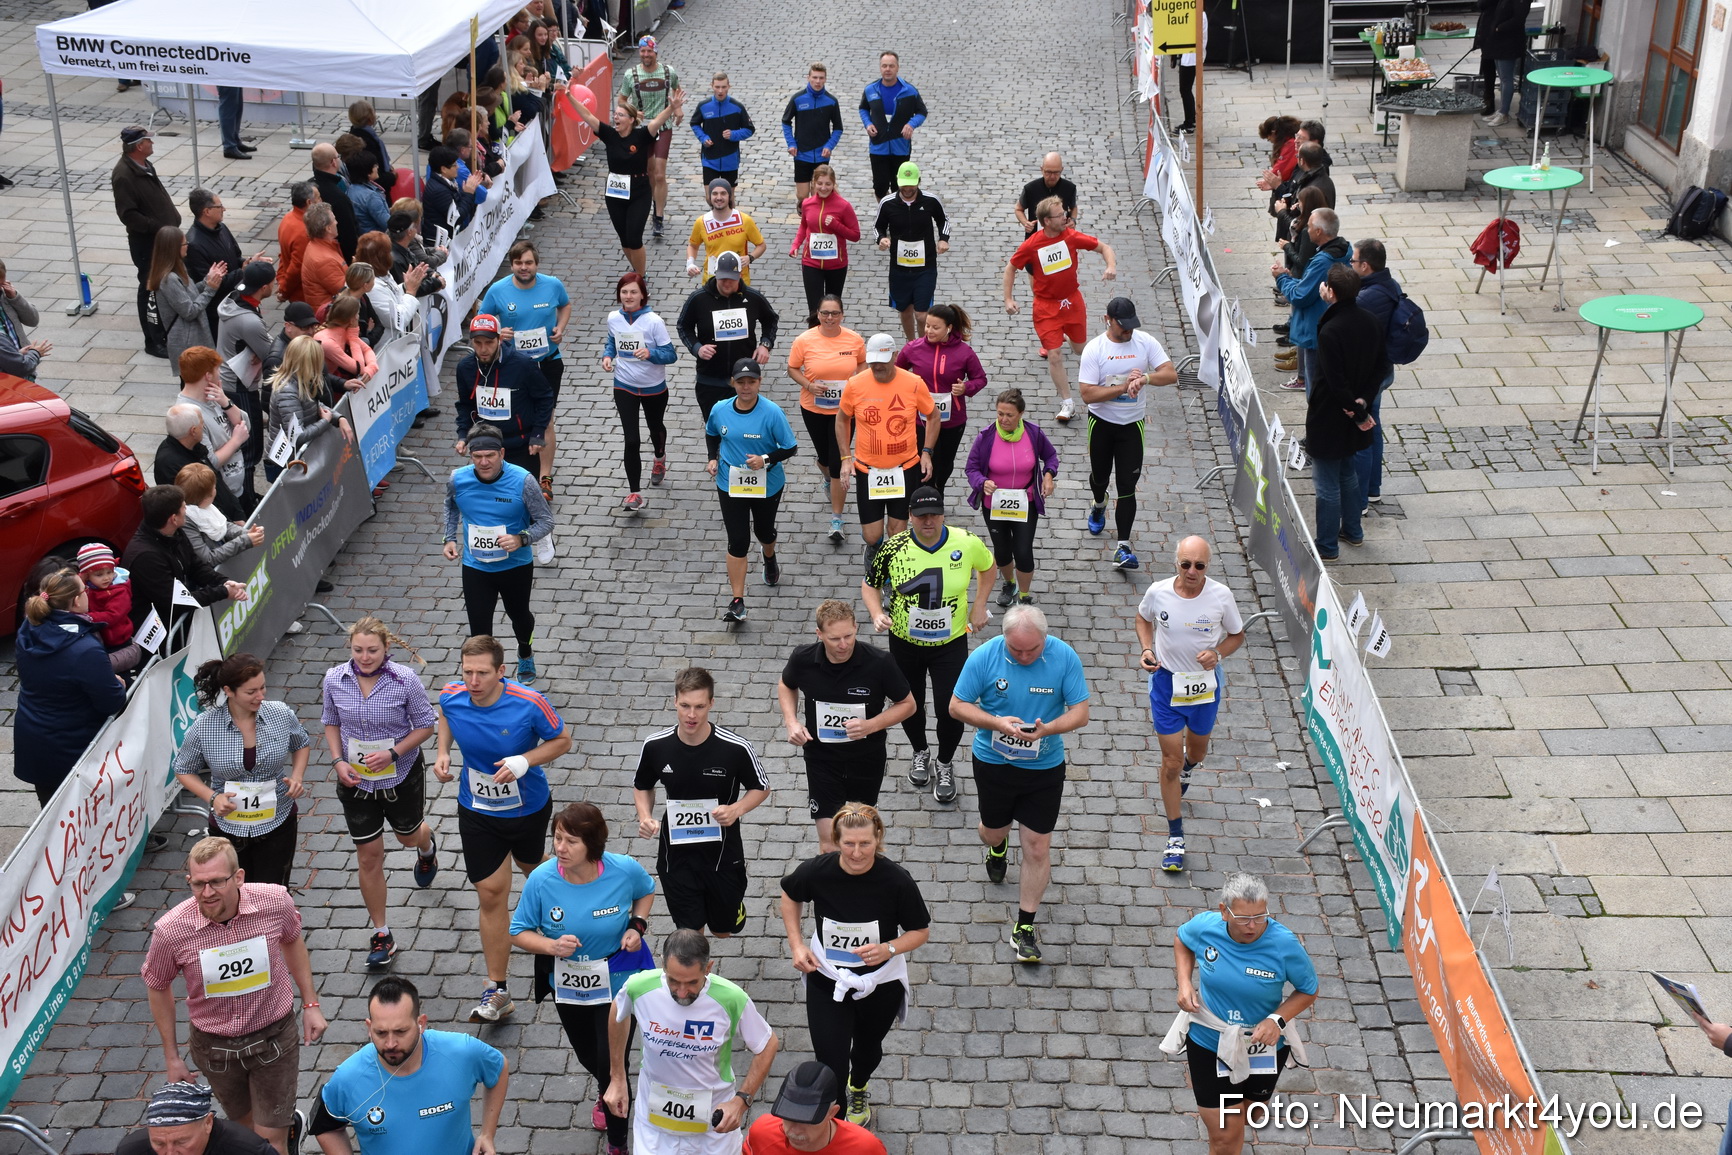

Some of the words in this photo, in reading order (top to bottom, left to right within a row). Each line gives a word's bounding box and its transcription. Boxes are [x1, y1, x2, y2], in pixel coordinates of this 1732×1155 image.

[1168, 13, 1189, 25] lauf
[56, 36, 104, 53] BMW
[110, 40, 251, 64] ConnectedDrive
[59, 54, 116, 70] Vernetzt,
[118, 62, 137, 70] um
[140, 60, 160, 72] frei
[162, 64, 176, 73] zu
[180, 64, 208, 75] sein.
[610, 180, 626, 190] 2343
[708, 232, 724, 242] MAX
[726, 228, 744, 236] BÖGL
[813, 240, 833, 250] 2732
[904, 250, 918, 258] 266
[1047, 251, 1062, 263] 407
[720, 318, 743, 329] 2658
[520, 338, 543, 348] 2521
[619, 340, 640, 350] 2657
[367, 359, 414, 418] RAILONE
[480, 396, 505, 408] 2404
[274, 442, 287, 460] swn
[738, 476, 758, 486] 148
[876, 475, 895, 486] 241
[1000, 500, 1020, 510] 225
[474, 538, 500, 549] 2654
[219, 557, 268, 652] BOCK
[914, 618, 946, 630] 2665
[143, 625, 158, 645] swn
[1374, 629, 1387, 652] swn
[1184, 683, 1207, 696] 192
[476, 782, 510, 796] 2114
[242, 796, 260, 810] 14
[675, 812, 710, 826] 2261
[592, 906, 620, 918] BOCK
[218, 957, 254, 981] 292
[1246, 968, 1276, 980] BOCK
[562, 972, 602, 988] 2302
[1227, 1010, 1244, 1021] 18.
[1462, 1014, 1470, 1028] die
[1464, 994, 1488, 1042] Neumarkts
[12, 988, 67, 1075] Service-Line:
[650, 1021, 680, 1038] TEAM
[660, 1049, 696, 1061] FEUCHT
[1248, 1042, 1268, 1055] 02
[420, 1102, 454, 1117] BOCK
[662, 1100, 696, 1120] 404
